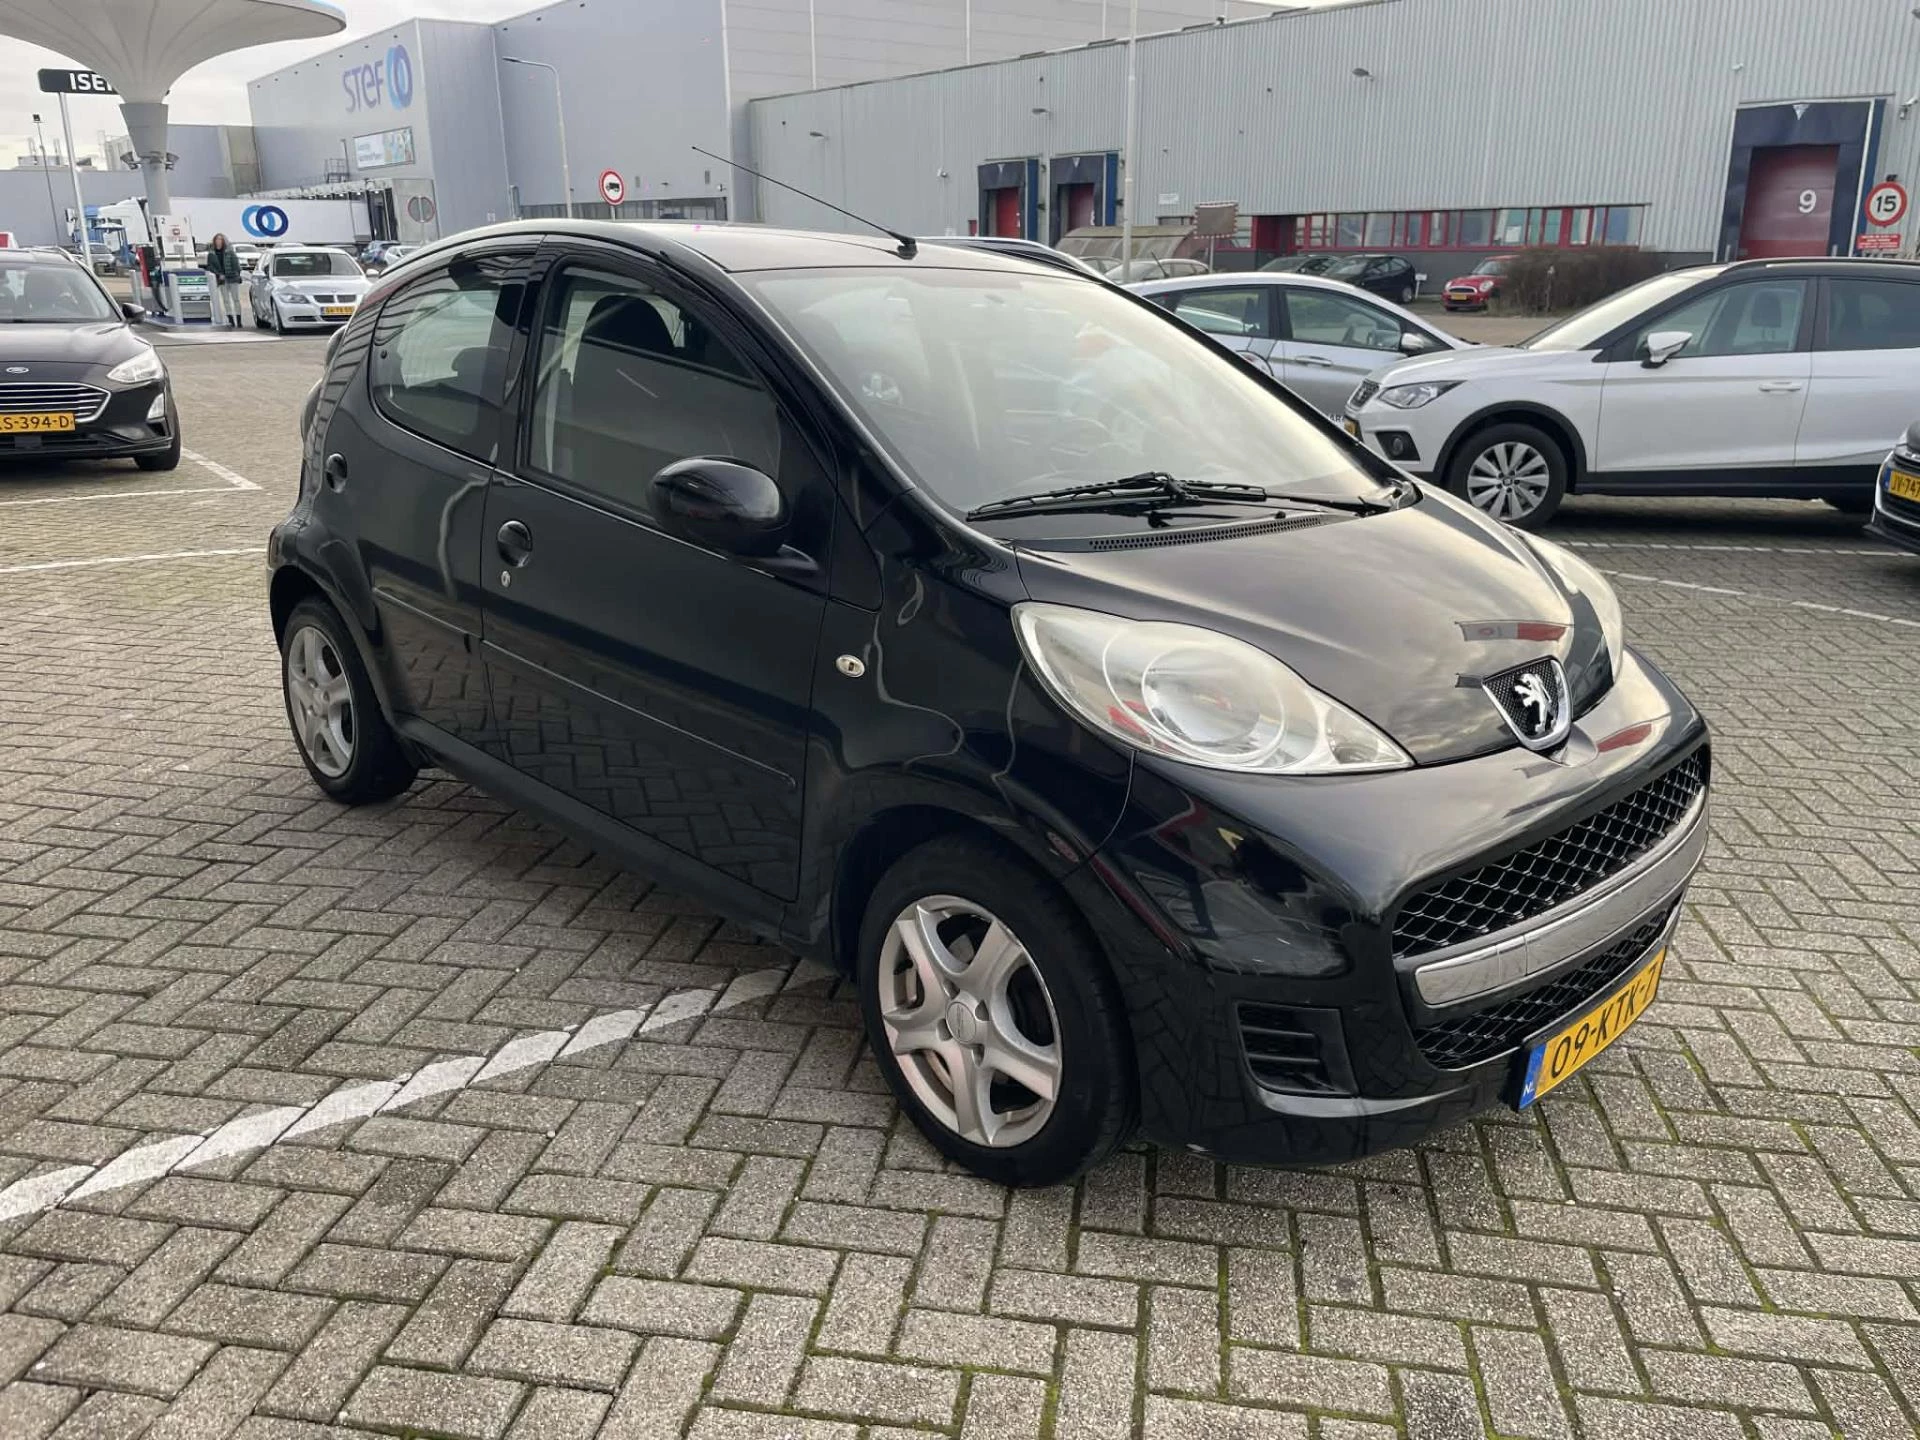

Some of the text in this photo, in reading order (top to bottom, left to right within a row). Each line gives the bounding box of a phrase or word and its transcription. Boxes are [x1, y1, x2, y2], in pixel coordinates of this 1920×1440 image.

[1798, 189, 1817, 213] 9
[1876, 195, 1897, 213] 15
[0, 415, 70, 431] S-394-D
[1551, 961, 1658, 1079] 09-KTK-7
[1523, 1080, 1535, 1097] NL
